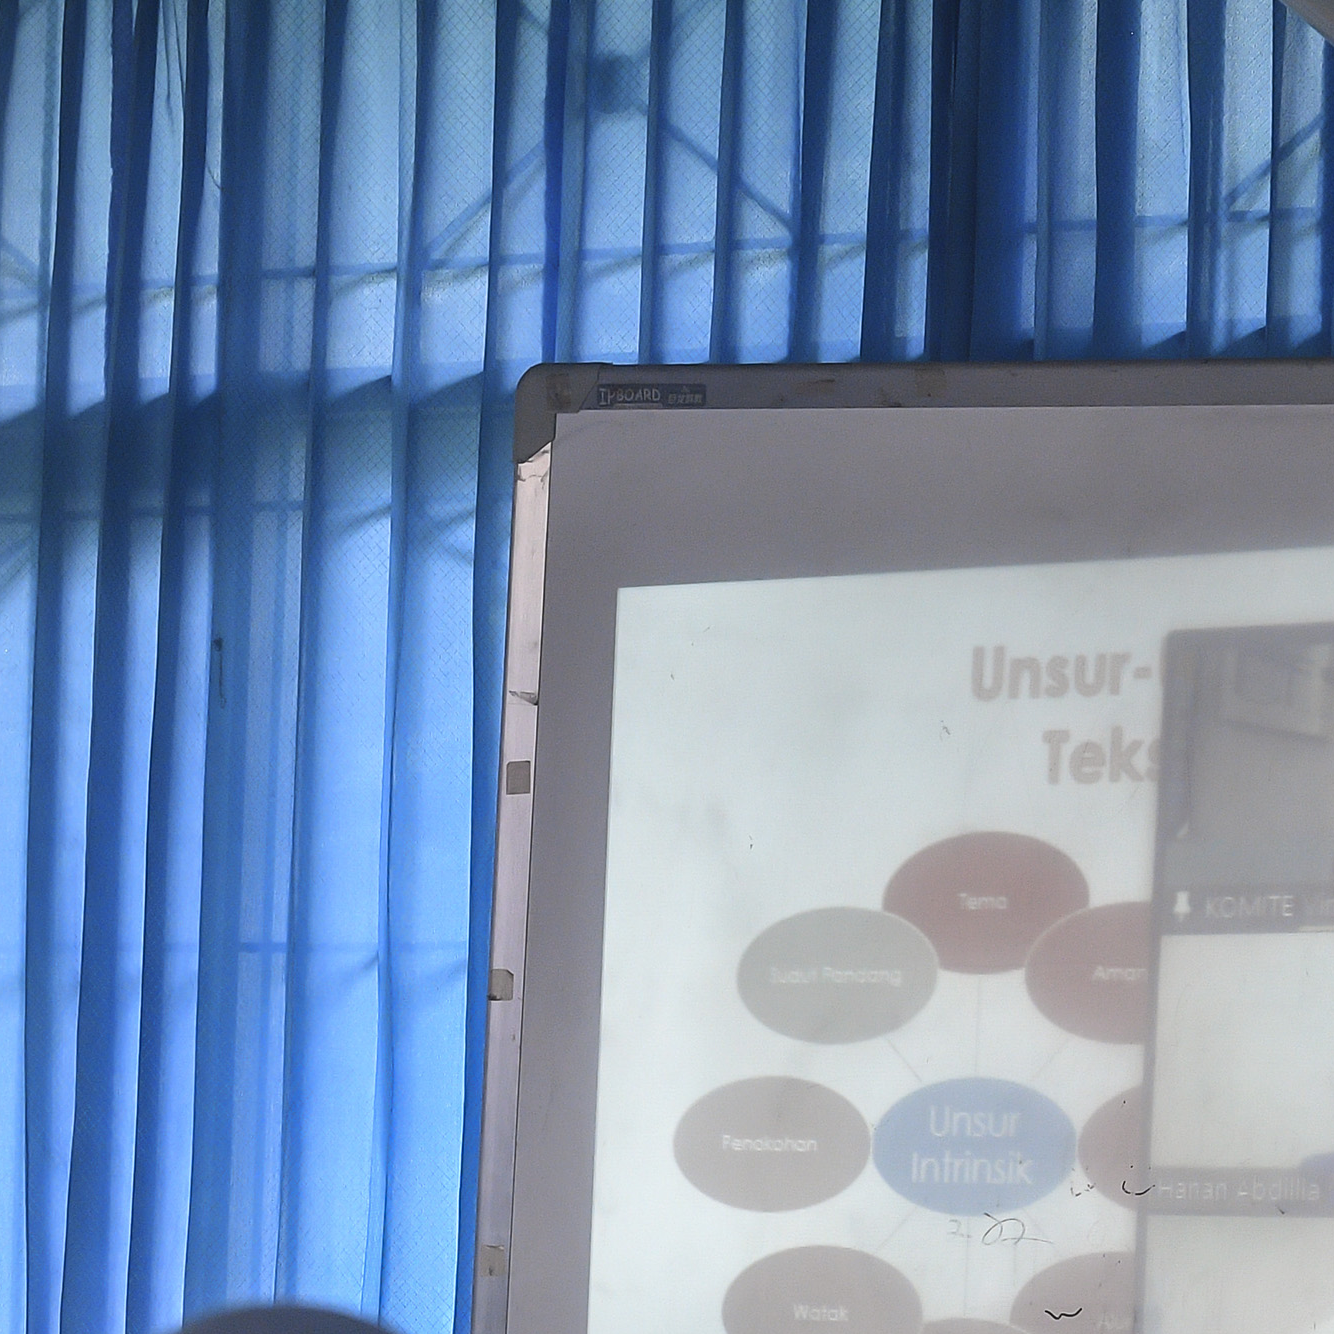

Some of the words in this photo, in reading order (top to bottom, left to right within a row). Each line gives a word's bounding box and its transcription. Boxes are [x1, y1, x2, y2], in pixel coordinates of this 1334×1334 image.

[957, 892, 1009, 911] Tema
[1204, 895, 1295, 919] KOMITE
[929, 1106, 1018, 1139] Unsur
[721, 1133, 818, 1153] Penokohan
[910, 1151, 1033, 1187] Intrinsik
[793, 1303, 849, 1324] Watak
